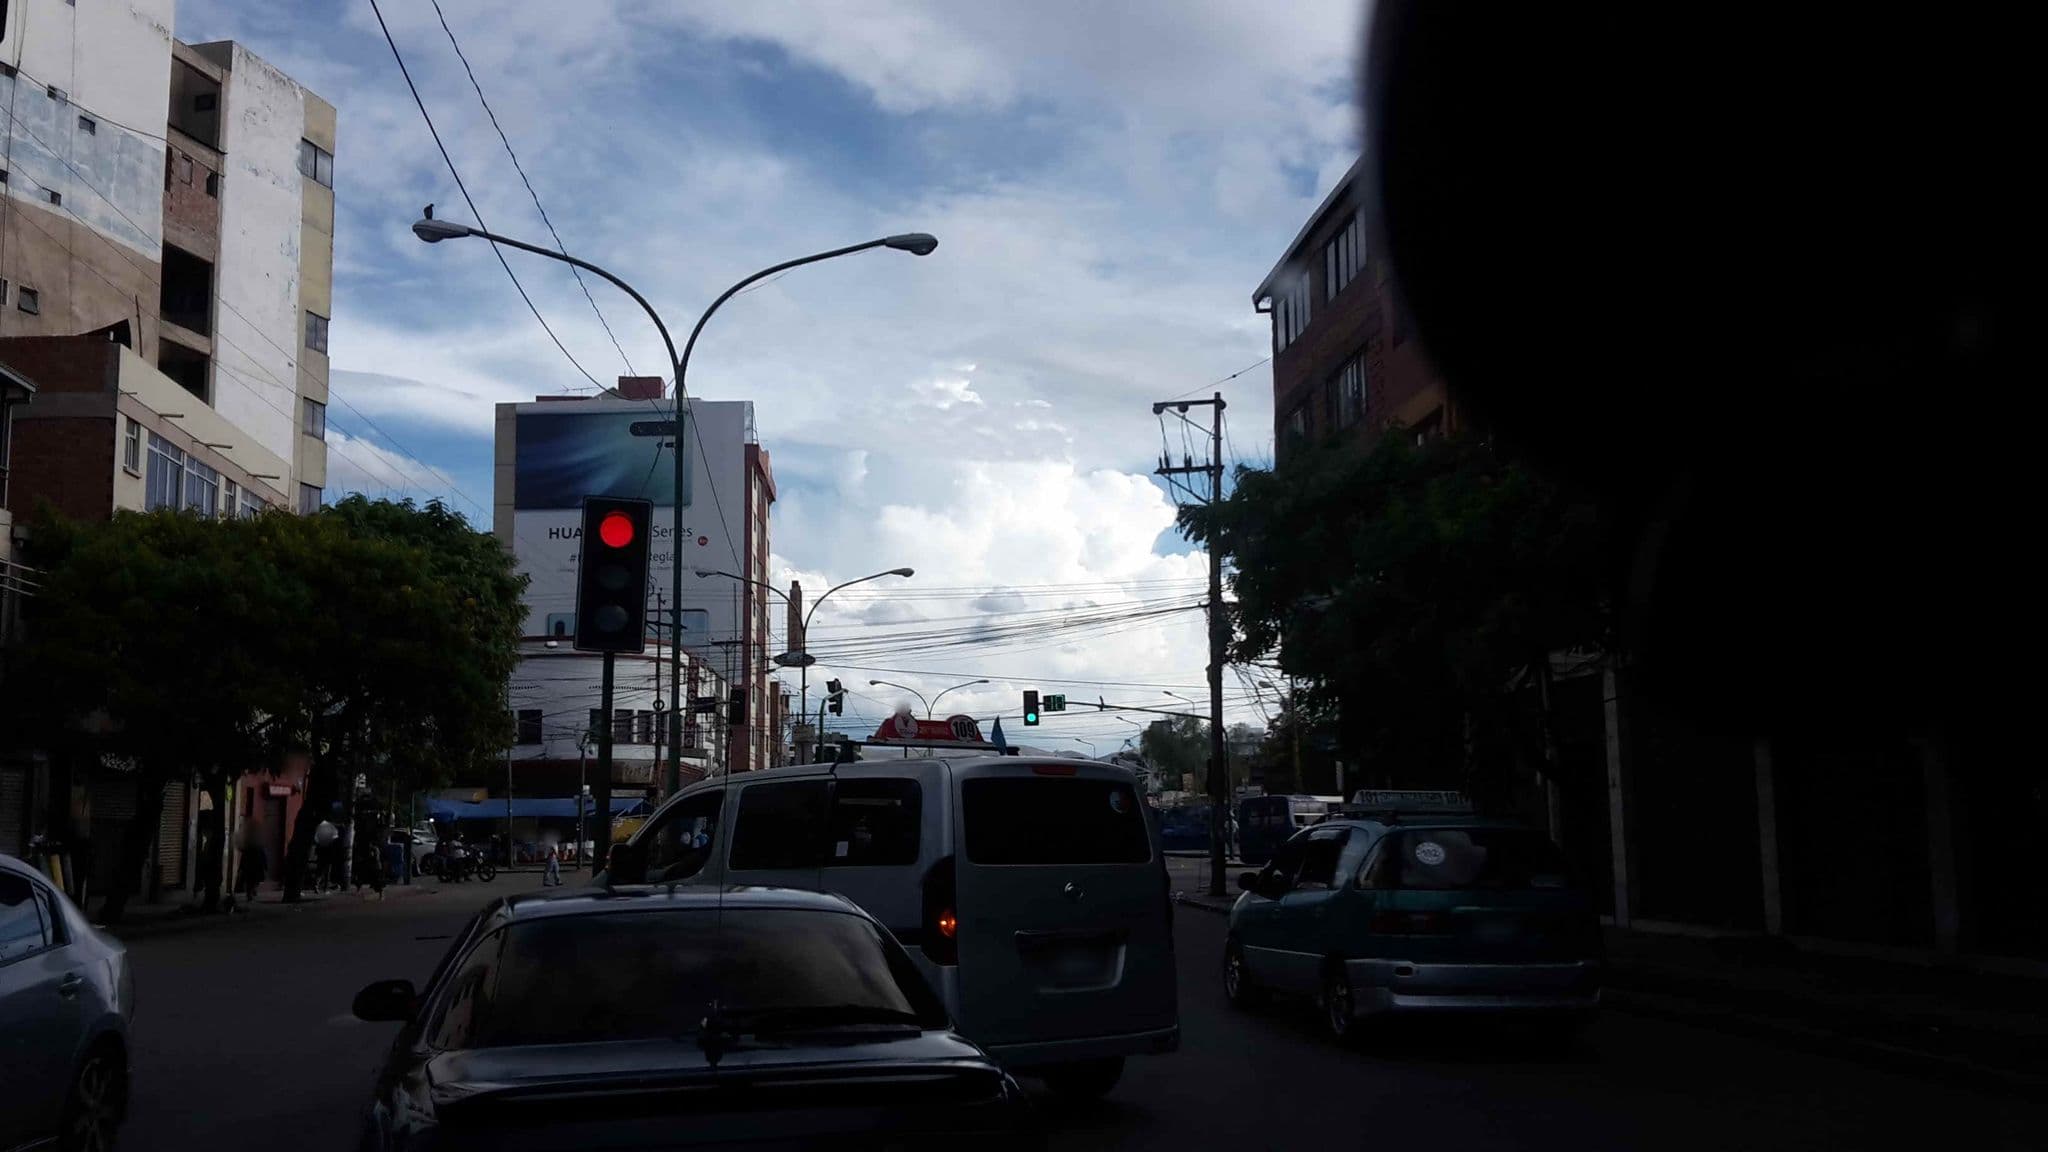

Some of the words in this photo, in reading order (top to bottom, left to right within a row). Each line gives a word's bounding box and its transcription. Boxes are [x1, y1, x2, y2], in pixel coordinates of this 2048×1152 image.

[549, 527, 582, 539] HUA
[653, 525, 693, 538] Seres
[953, 721, 976, 738] 109
